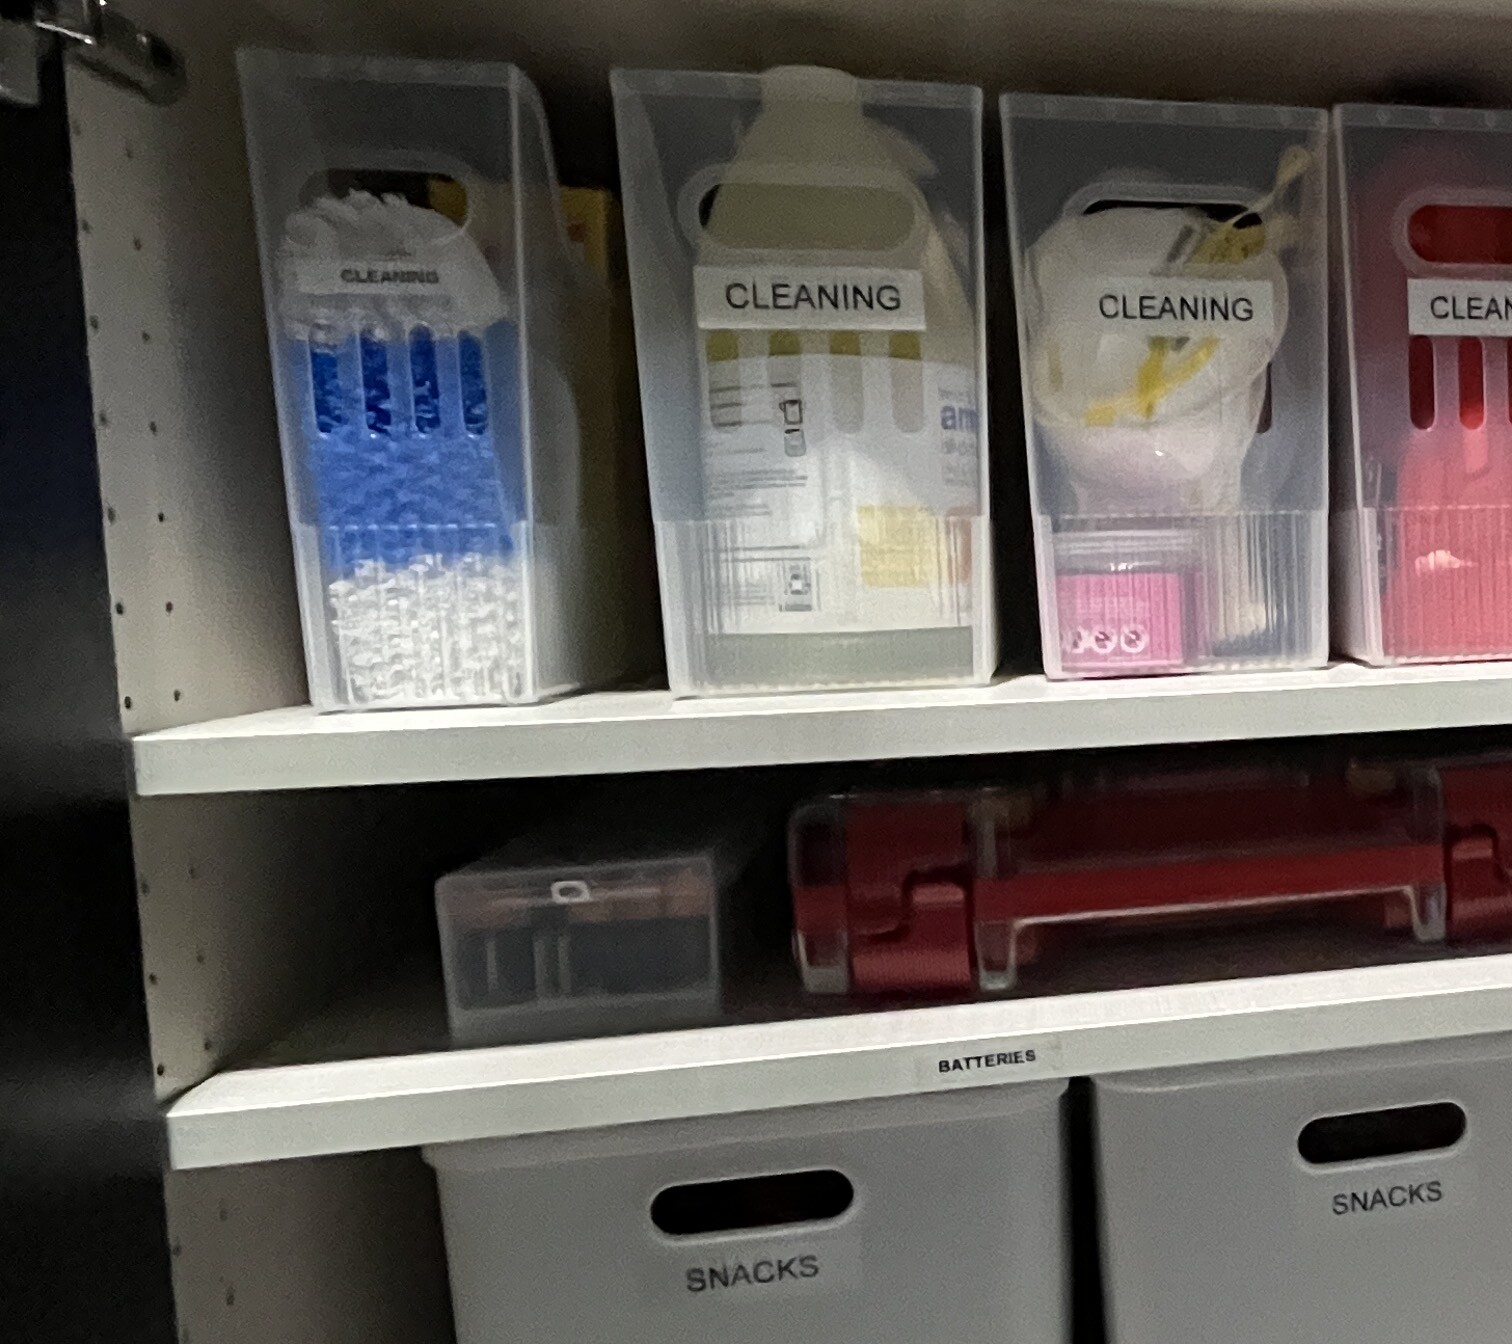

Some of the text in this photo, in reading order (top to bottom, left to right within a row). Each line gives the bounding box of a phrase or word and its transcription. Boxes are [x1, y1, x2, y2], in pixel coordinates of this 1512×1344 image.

[339, 268, 440, 284] CLEANING
[725, 283, 901, 311] CLEANING
[1098, 294, 1255, 322] CLEANING
[938, 1049, 1037, 1073] BATTERIES
[1332, 1180, 1443, 1215] SNACKS
[686, 1254, 820, 1293] SNACKS
